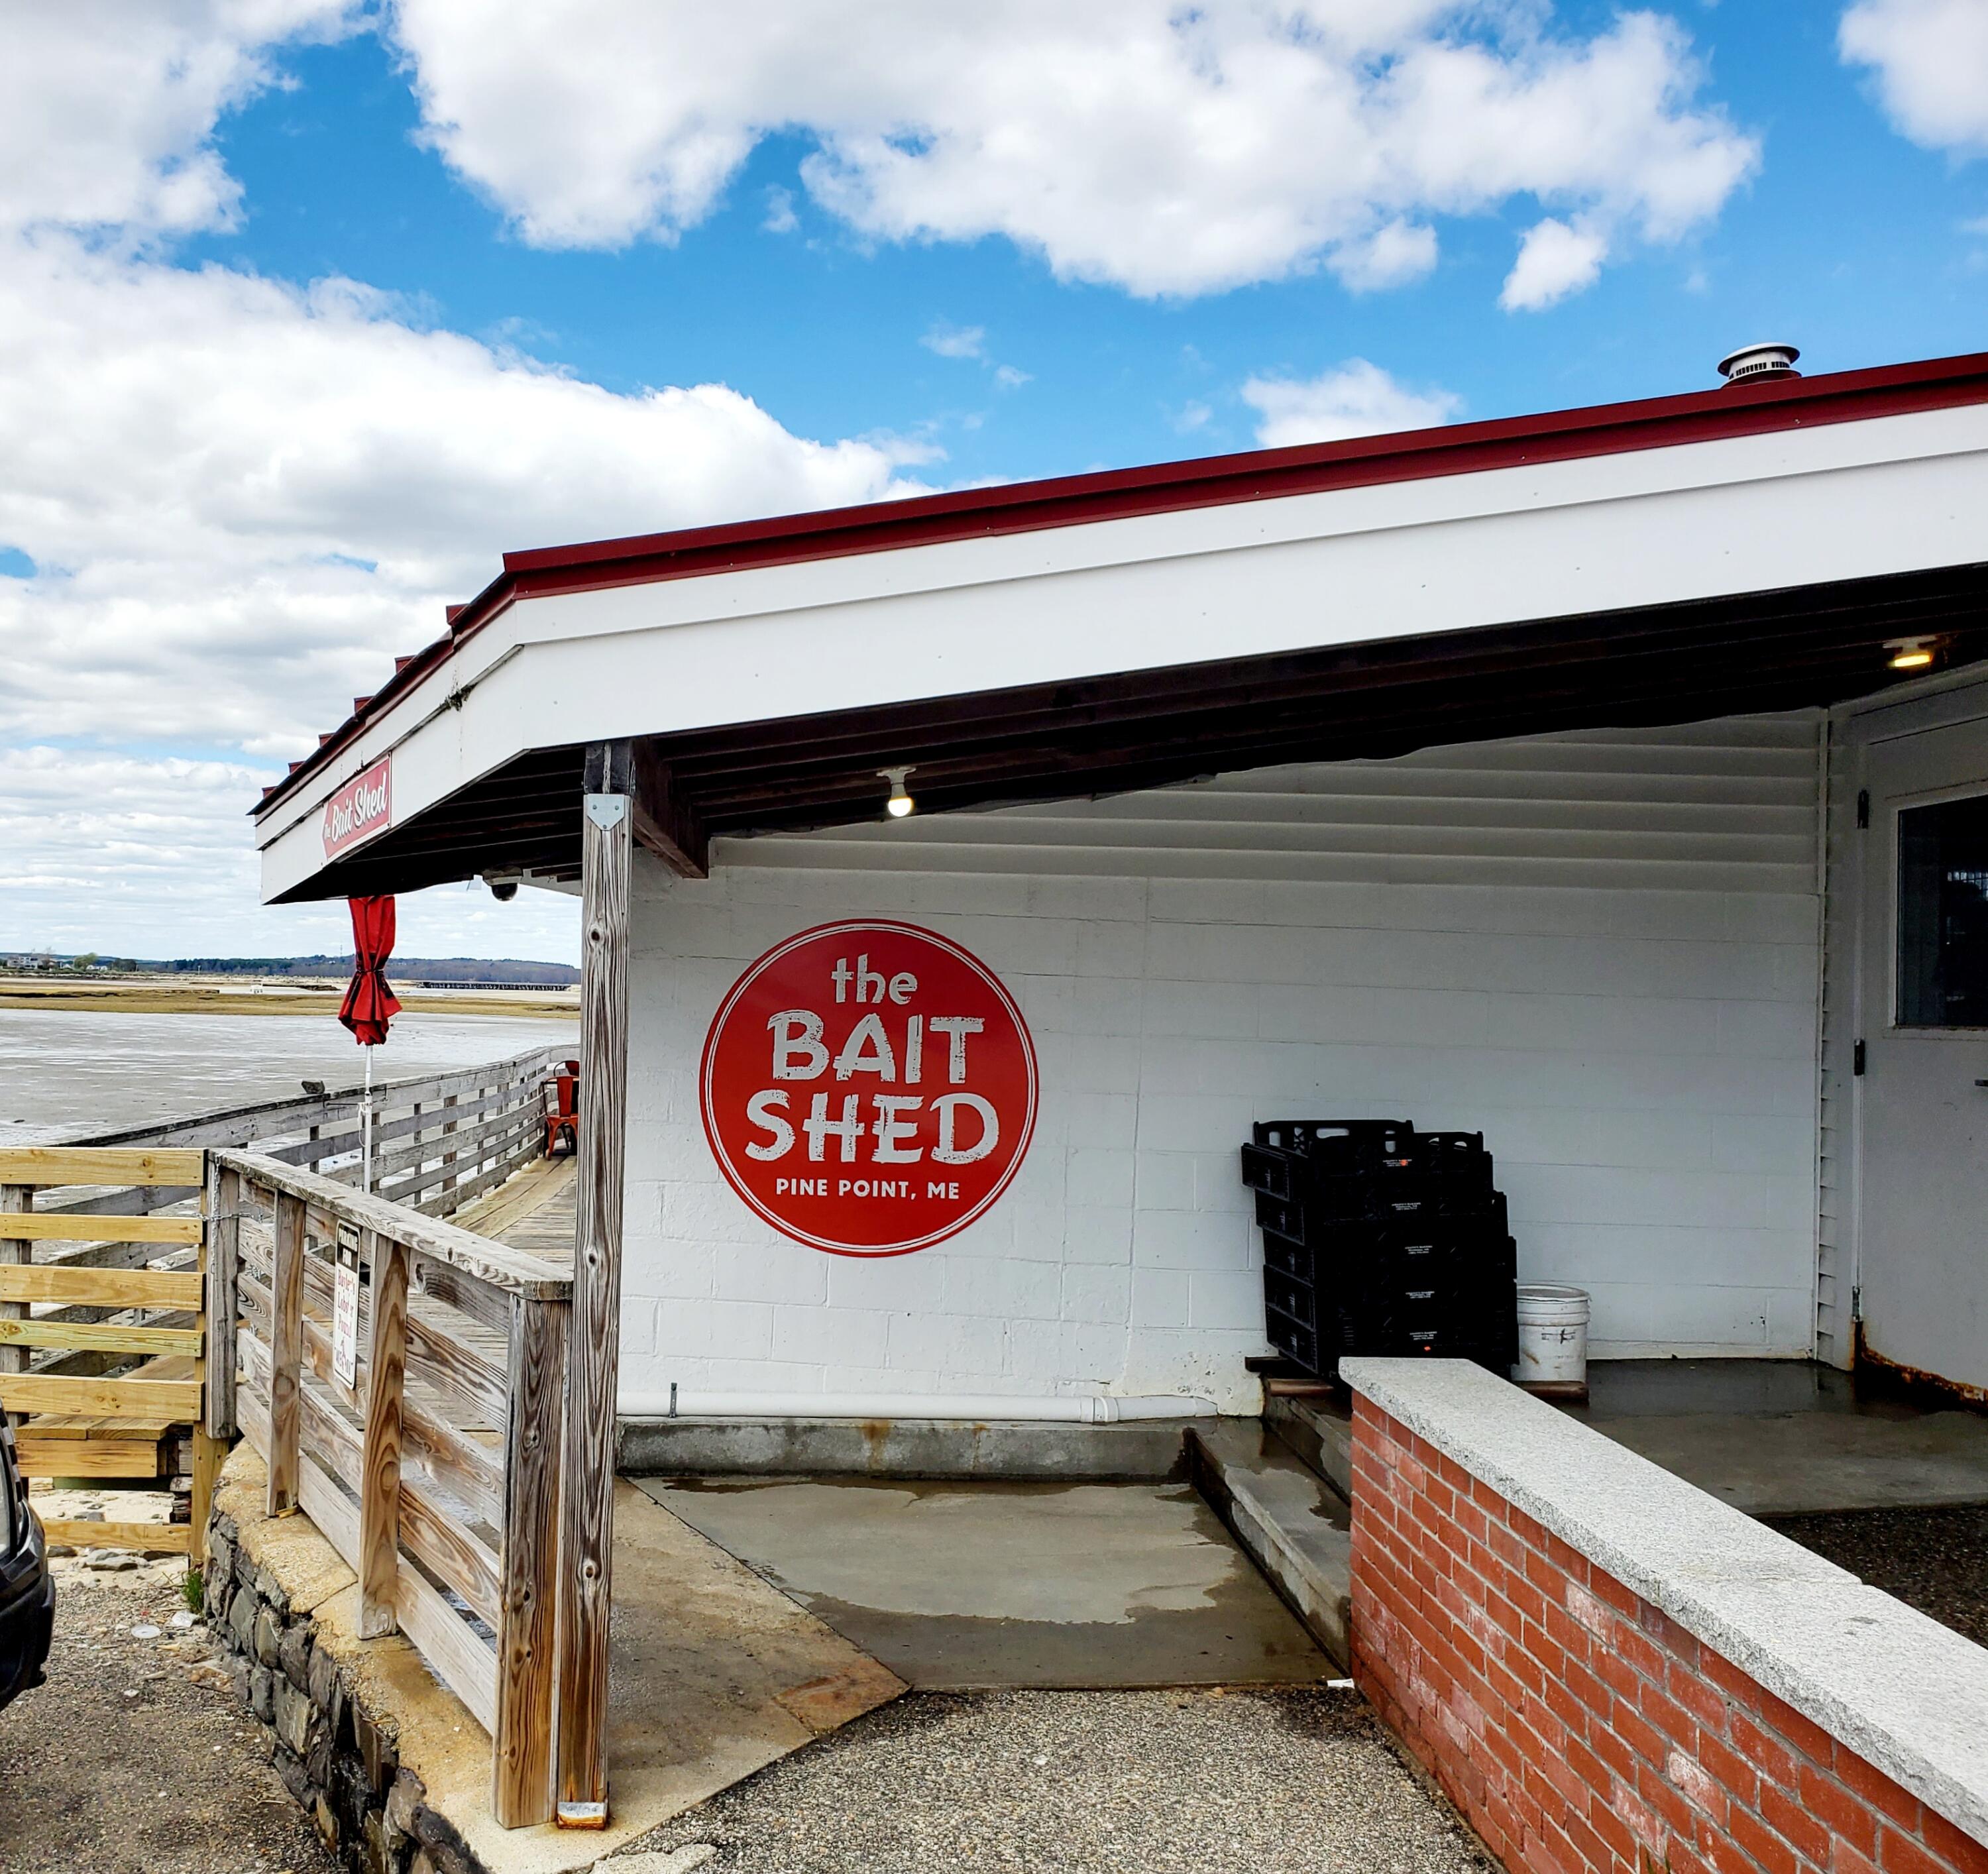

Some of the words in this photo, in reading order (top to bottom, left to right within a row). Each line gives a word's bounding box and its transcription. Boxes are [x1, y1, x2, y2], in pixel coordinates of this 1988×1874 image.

[331, 797, 353, 843] Bait
[354, 771, 388, 827] Shed
[831, 954, 918, 1005] the
[766, 1009, 985, 1084] BAIT
[744, 1089, 999, 1164] SHED
[775, 1178, 828, 1197] PINE
[838, 1180, 916, 1200] POINT,
[927, 1182, 960, 1199] ME
[338, 1227, 358, 1252] PARKING
[342, 1248, 353, 1267] FOR
[338, 1268, 355, 1295] Bayle's
[337, 1292, 354, 1317] Lobstr
[338, 1313, 351, 1337] Pound
